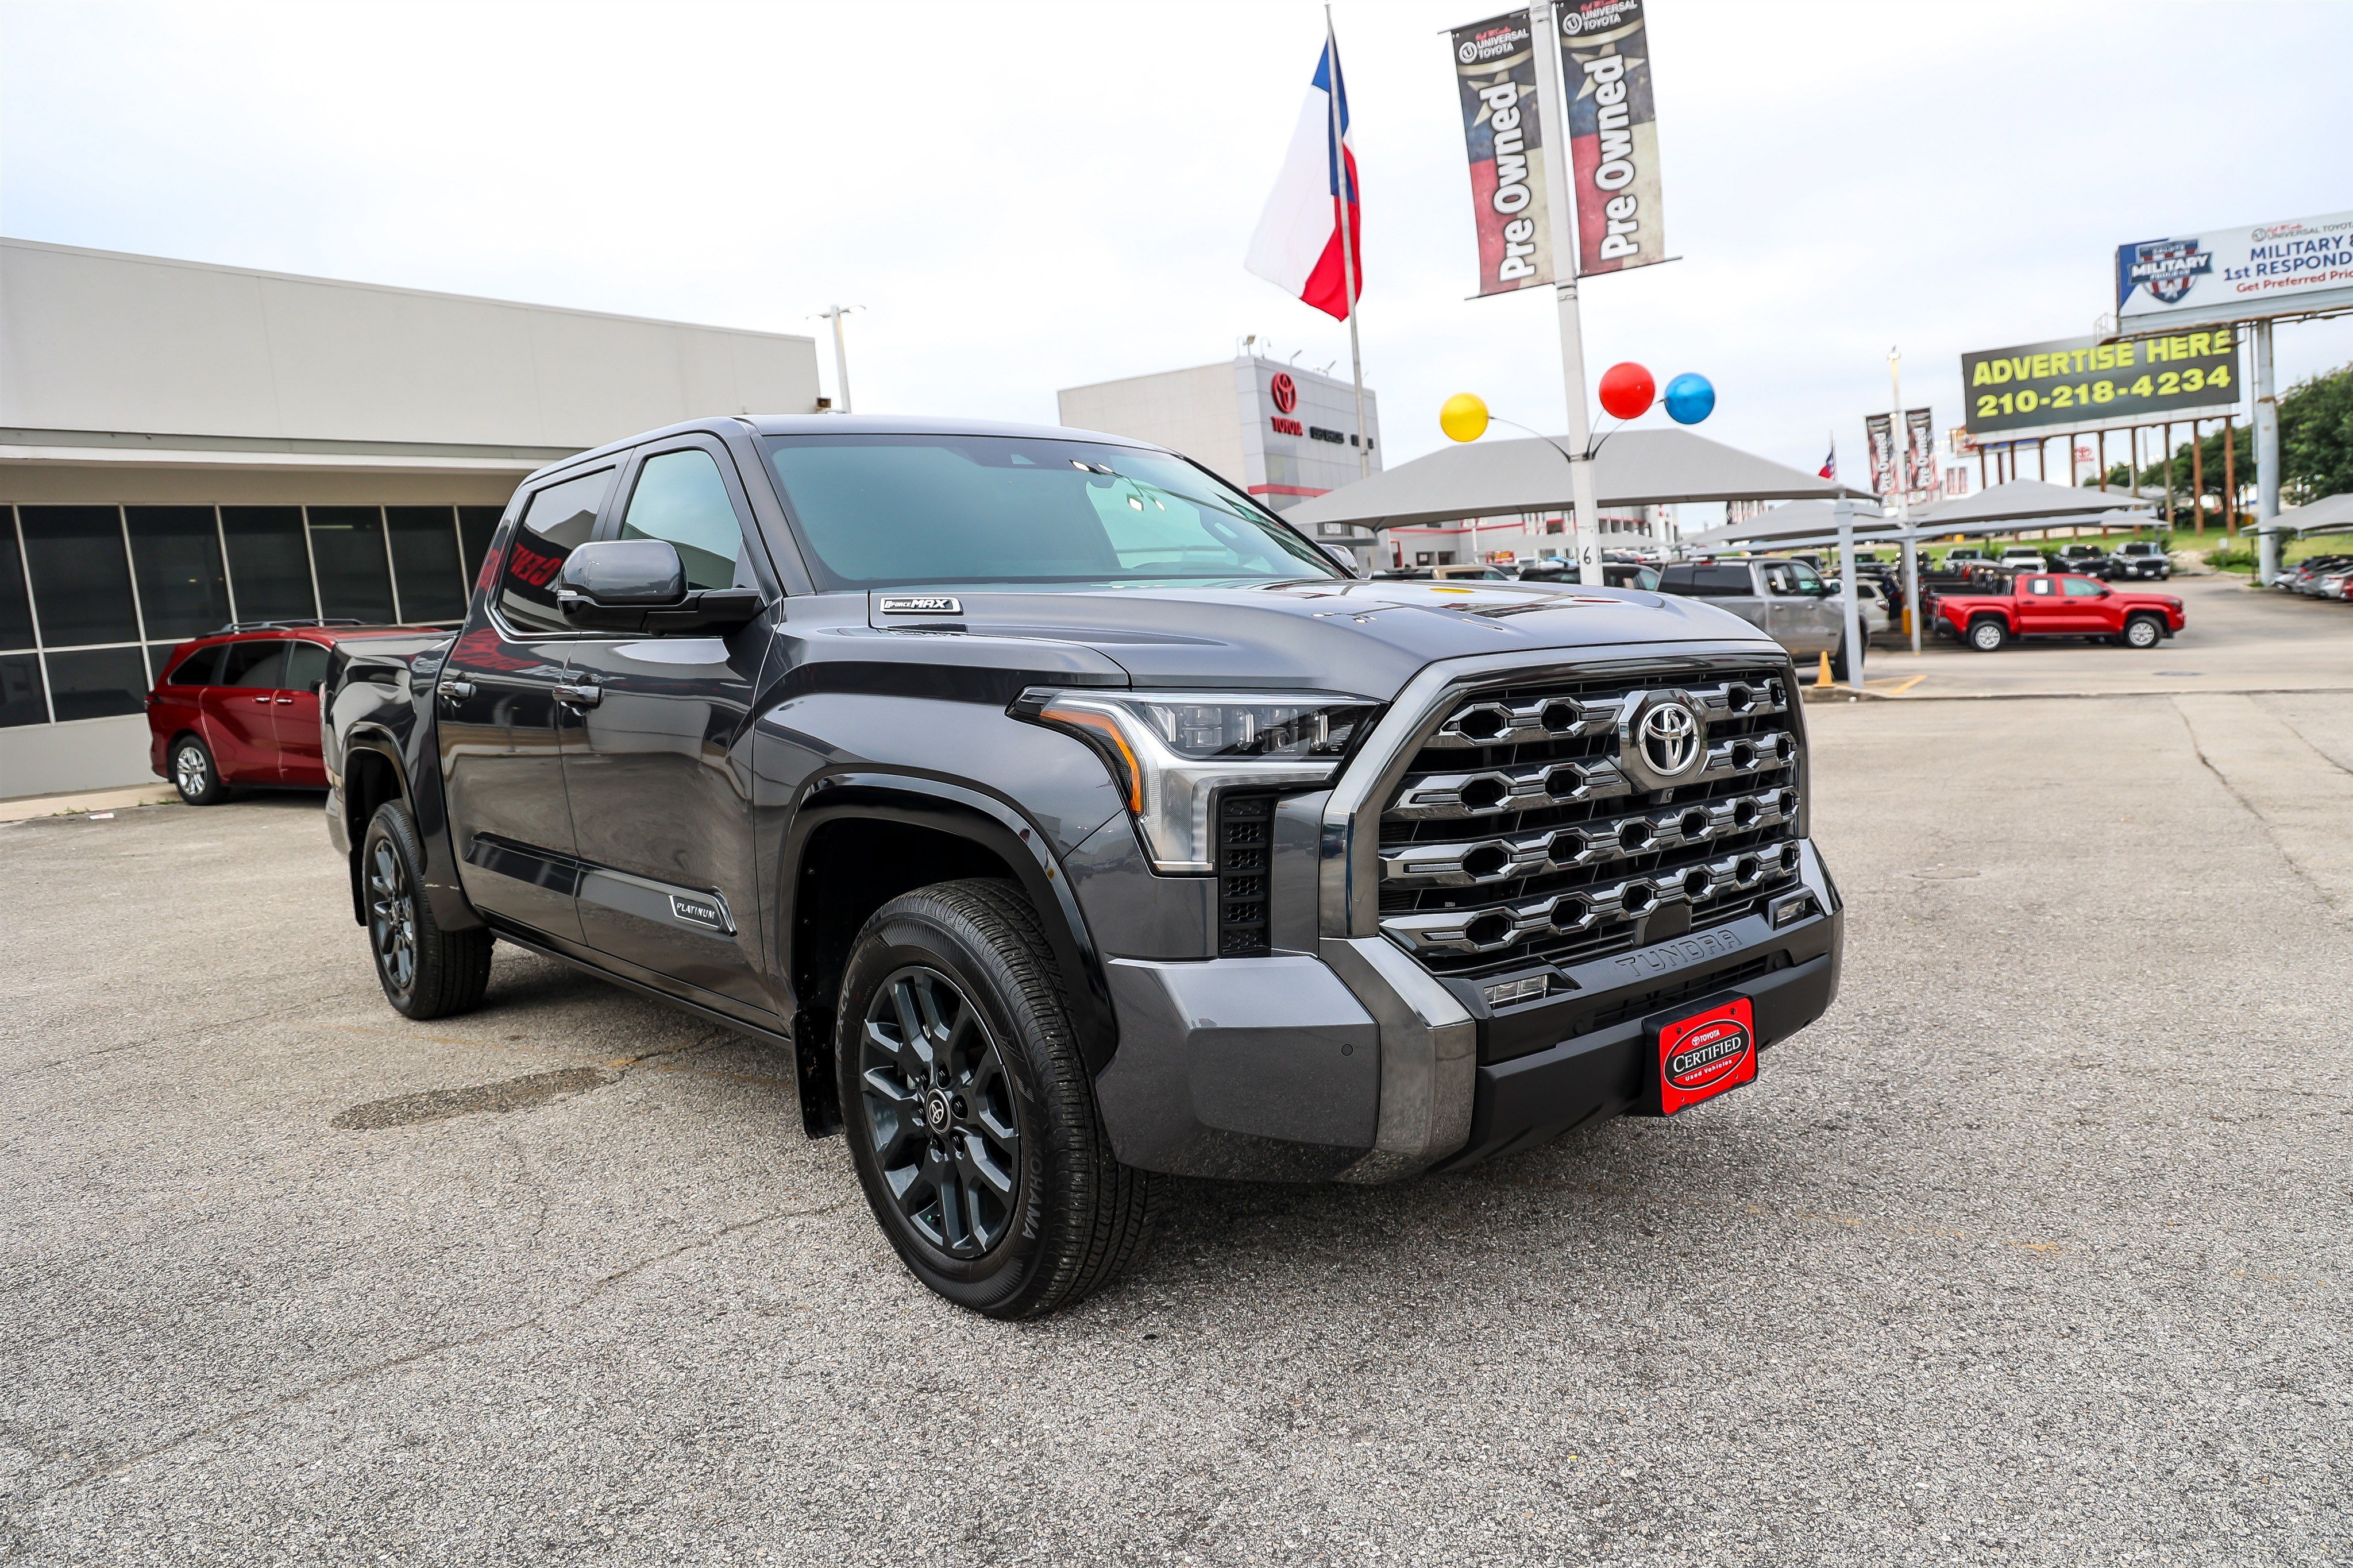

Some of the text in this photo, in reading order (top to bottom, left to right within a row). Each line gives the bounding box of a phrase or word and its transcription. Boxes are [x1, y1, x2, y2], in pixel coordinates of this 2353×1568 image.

[1581, 0, 1638, 20] UNIVERSAL
[1583, 13, 1621, 31] TOYOTA
[1476, 28, 1529, 49] UNIVERSAL
[1478, 42, 1514, 60] TOYOTA
[1584, 54, 1635, 191] Owned
[1479, 81, 1531, 214] Owned
[1600, 195, 1639, 260] Pre
[2323, 221, 2353, 232] TOYOT
[1499, 218, 1535, 281] Pre
[2251, 234, 2344, 262] MILITARY
[2132, 254, 2208, 277] MILITARY
[2224, 251, 2353, 281] 1st RESPOND
[2237, 281, 2259, 293] Get
[2263, 272, 2326, 289] Preferred
[1972, 329, 2233, 387] ADVERTISE HERE
[1976, 365, 2232, 418] 210-218-4234
[1271, 415, 1303, 436] TOYOTA
[1584, 546, 1591, 565] 6
[911, 600, 950, 609] MAX
[677, 902, 715, 920] PLATINUM
[1614, 929, 1743, 977] TUNDRA
[1700, 1029, 1721, 1042] TOYOTA
[1673, 1037, 1742, 1073] CERTIFIED
[1685, 1059, 1733, 1082] Used Vehicles
